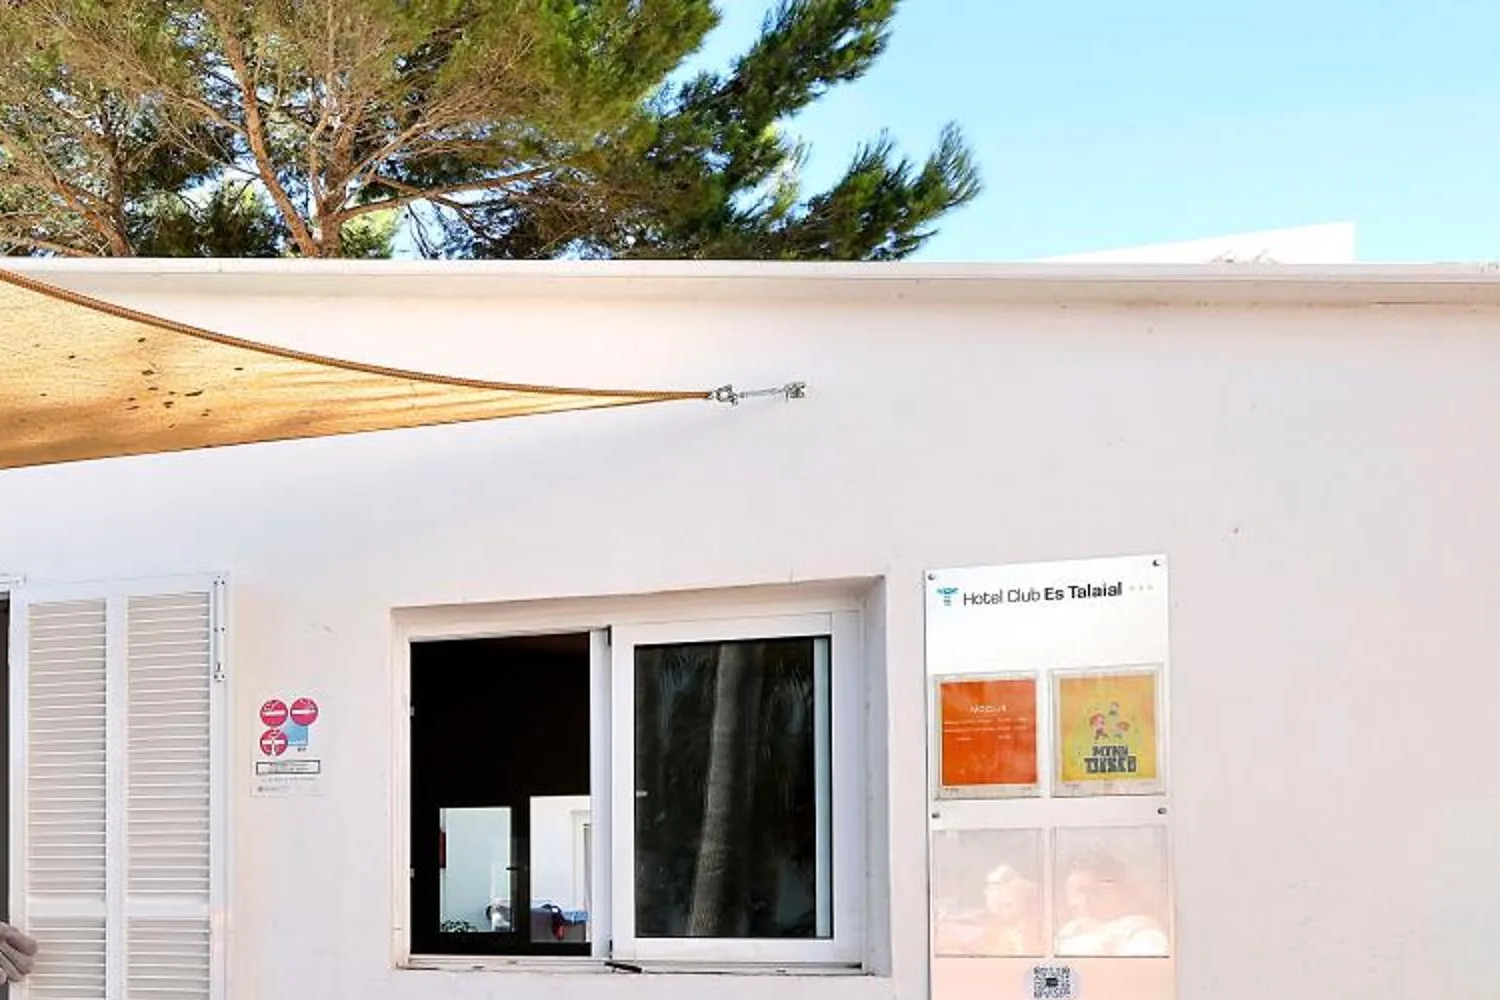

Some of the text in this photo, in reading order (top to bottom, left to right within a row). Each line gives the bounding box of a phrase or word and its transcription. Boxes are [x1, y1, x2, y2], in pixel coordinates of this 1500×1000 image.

[963, 581, 1123, 606] Hotel Club Es Talaial
